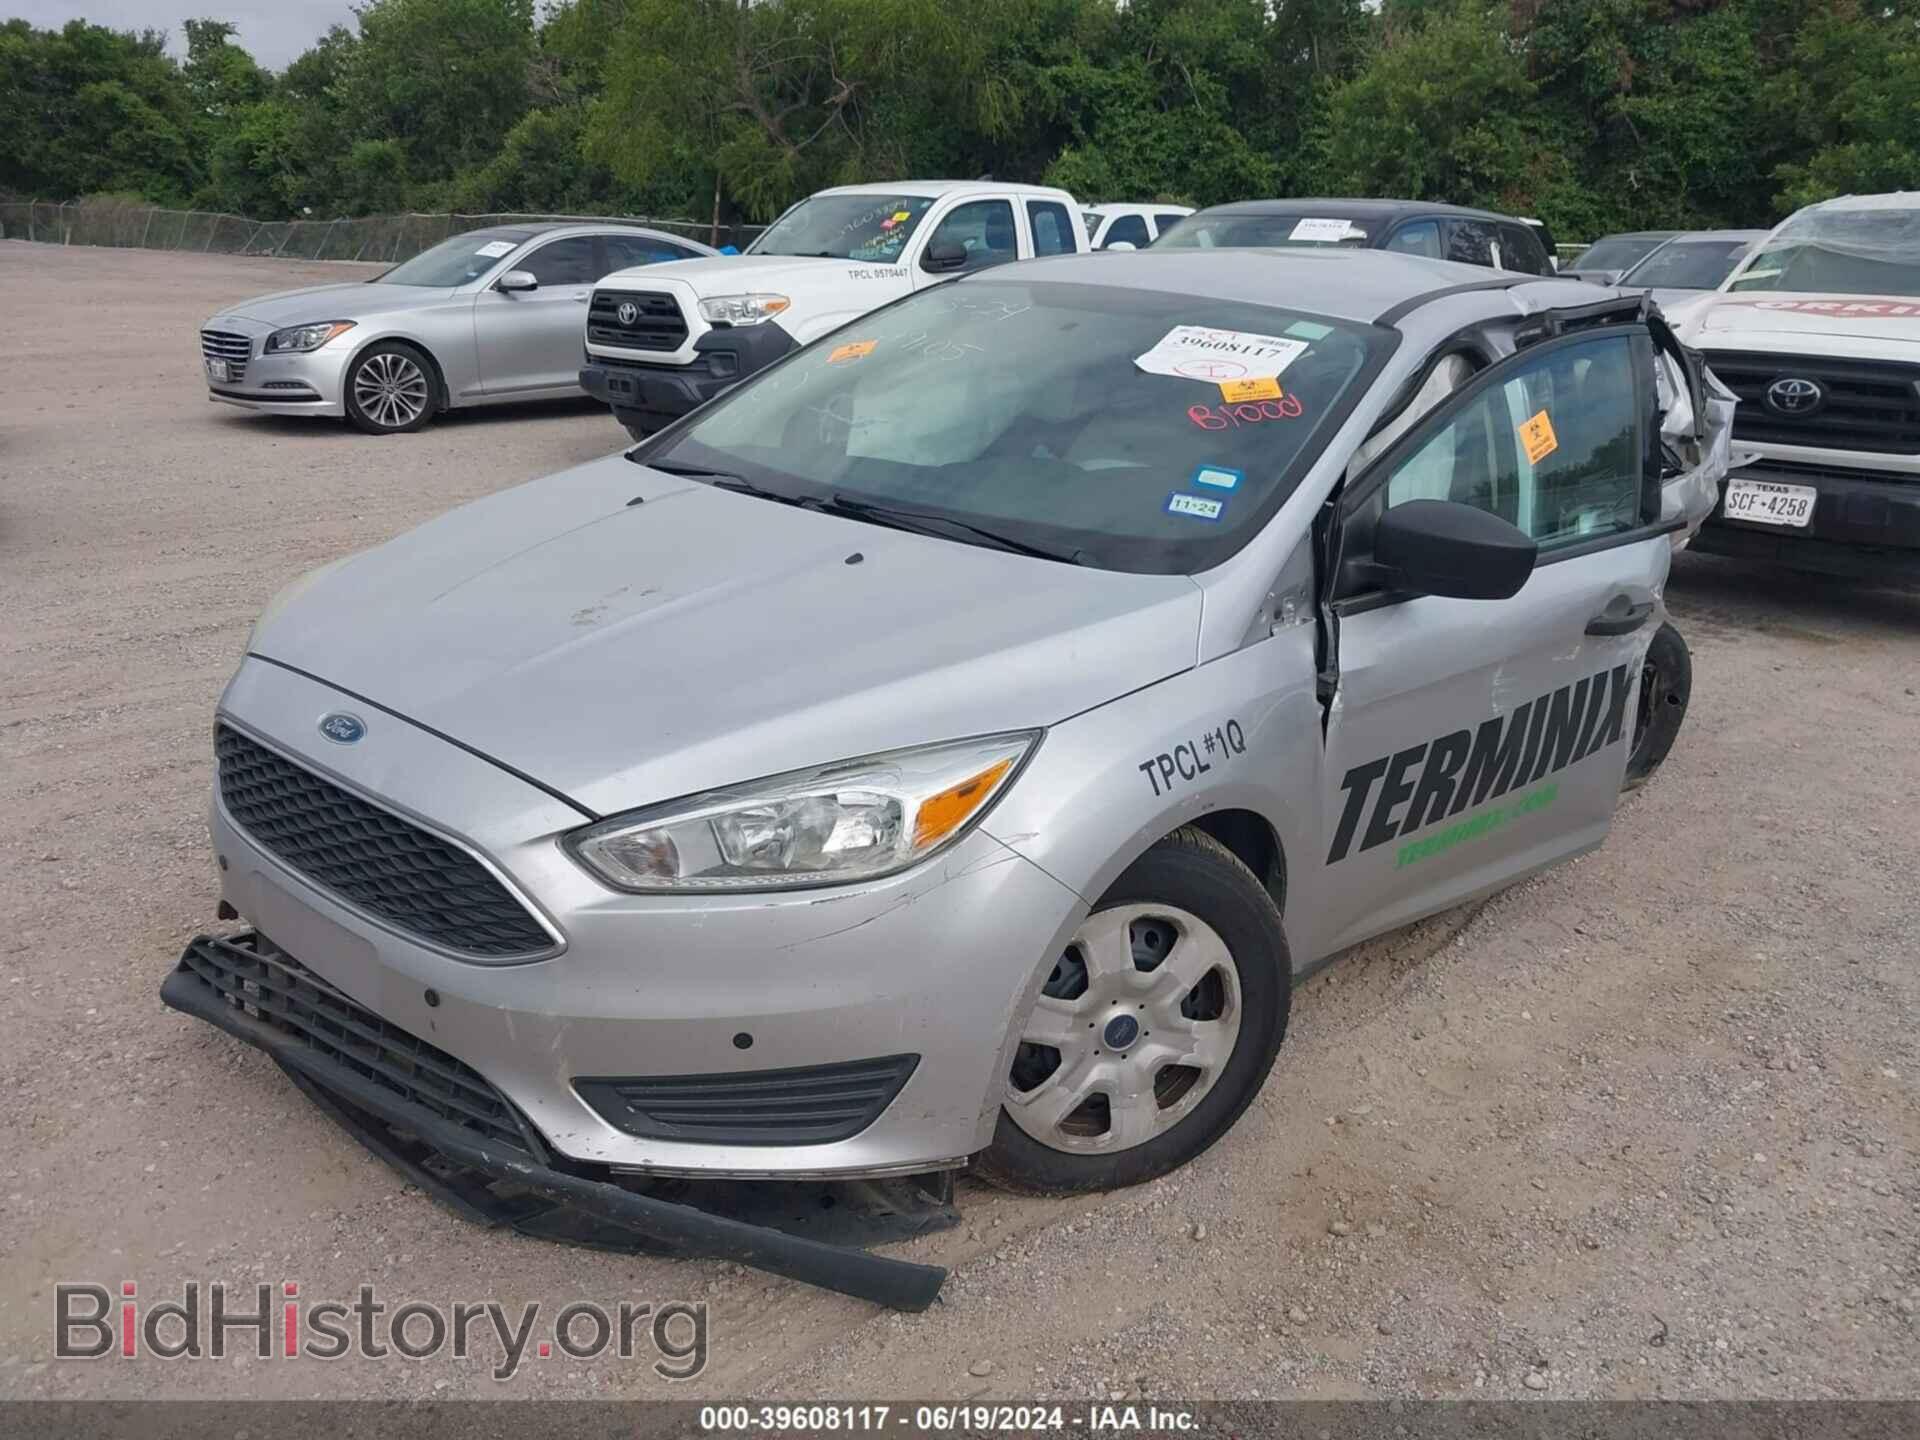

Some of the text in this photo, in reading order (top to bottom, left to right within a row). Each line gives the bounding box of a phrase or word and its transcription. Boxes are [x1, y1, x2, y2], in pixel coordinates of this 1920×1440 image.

[848, 269, 873, 280] TPCL
[1753, 301, 1920, 315] ORKI
[1756, 483, 1789, 494] TEXAS
[1326, 663, 1634, 866] TERMINIX
